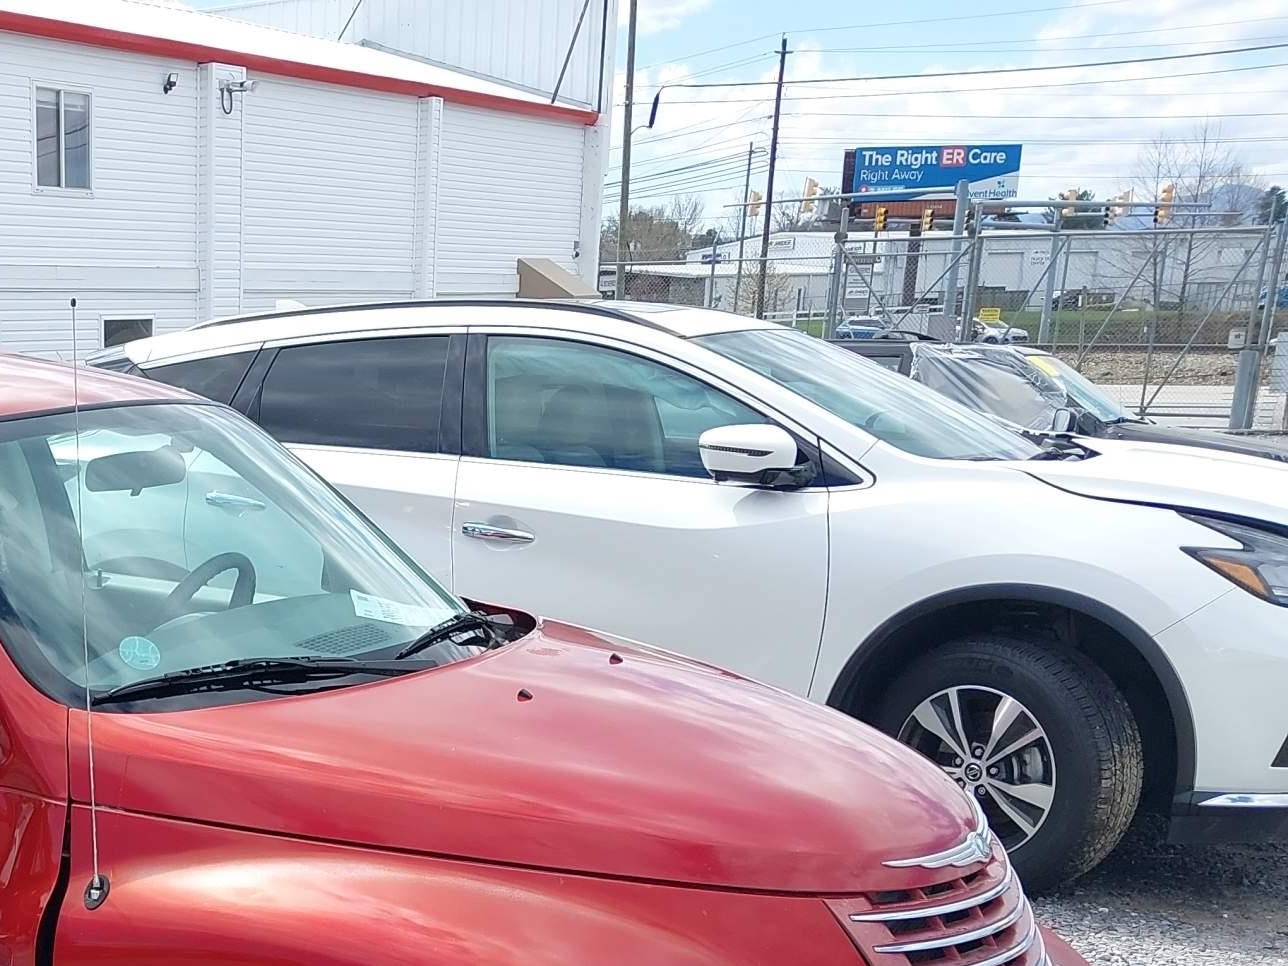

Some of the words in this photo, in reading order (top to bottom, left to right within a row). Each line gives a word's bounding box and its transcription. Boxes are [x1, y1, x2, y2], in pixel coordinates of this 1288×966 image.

[862, 150, 892, 166] The
[896, 149, 938, 169] Right
[942, 148, 965, 165] ER
[968, 148, 1007, 164] Care
[860, 169, 889, 183] Right
[891, 168, 925, 182] Away
